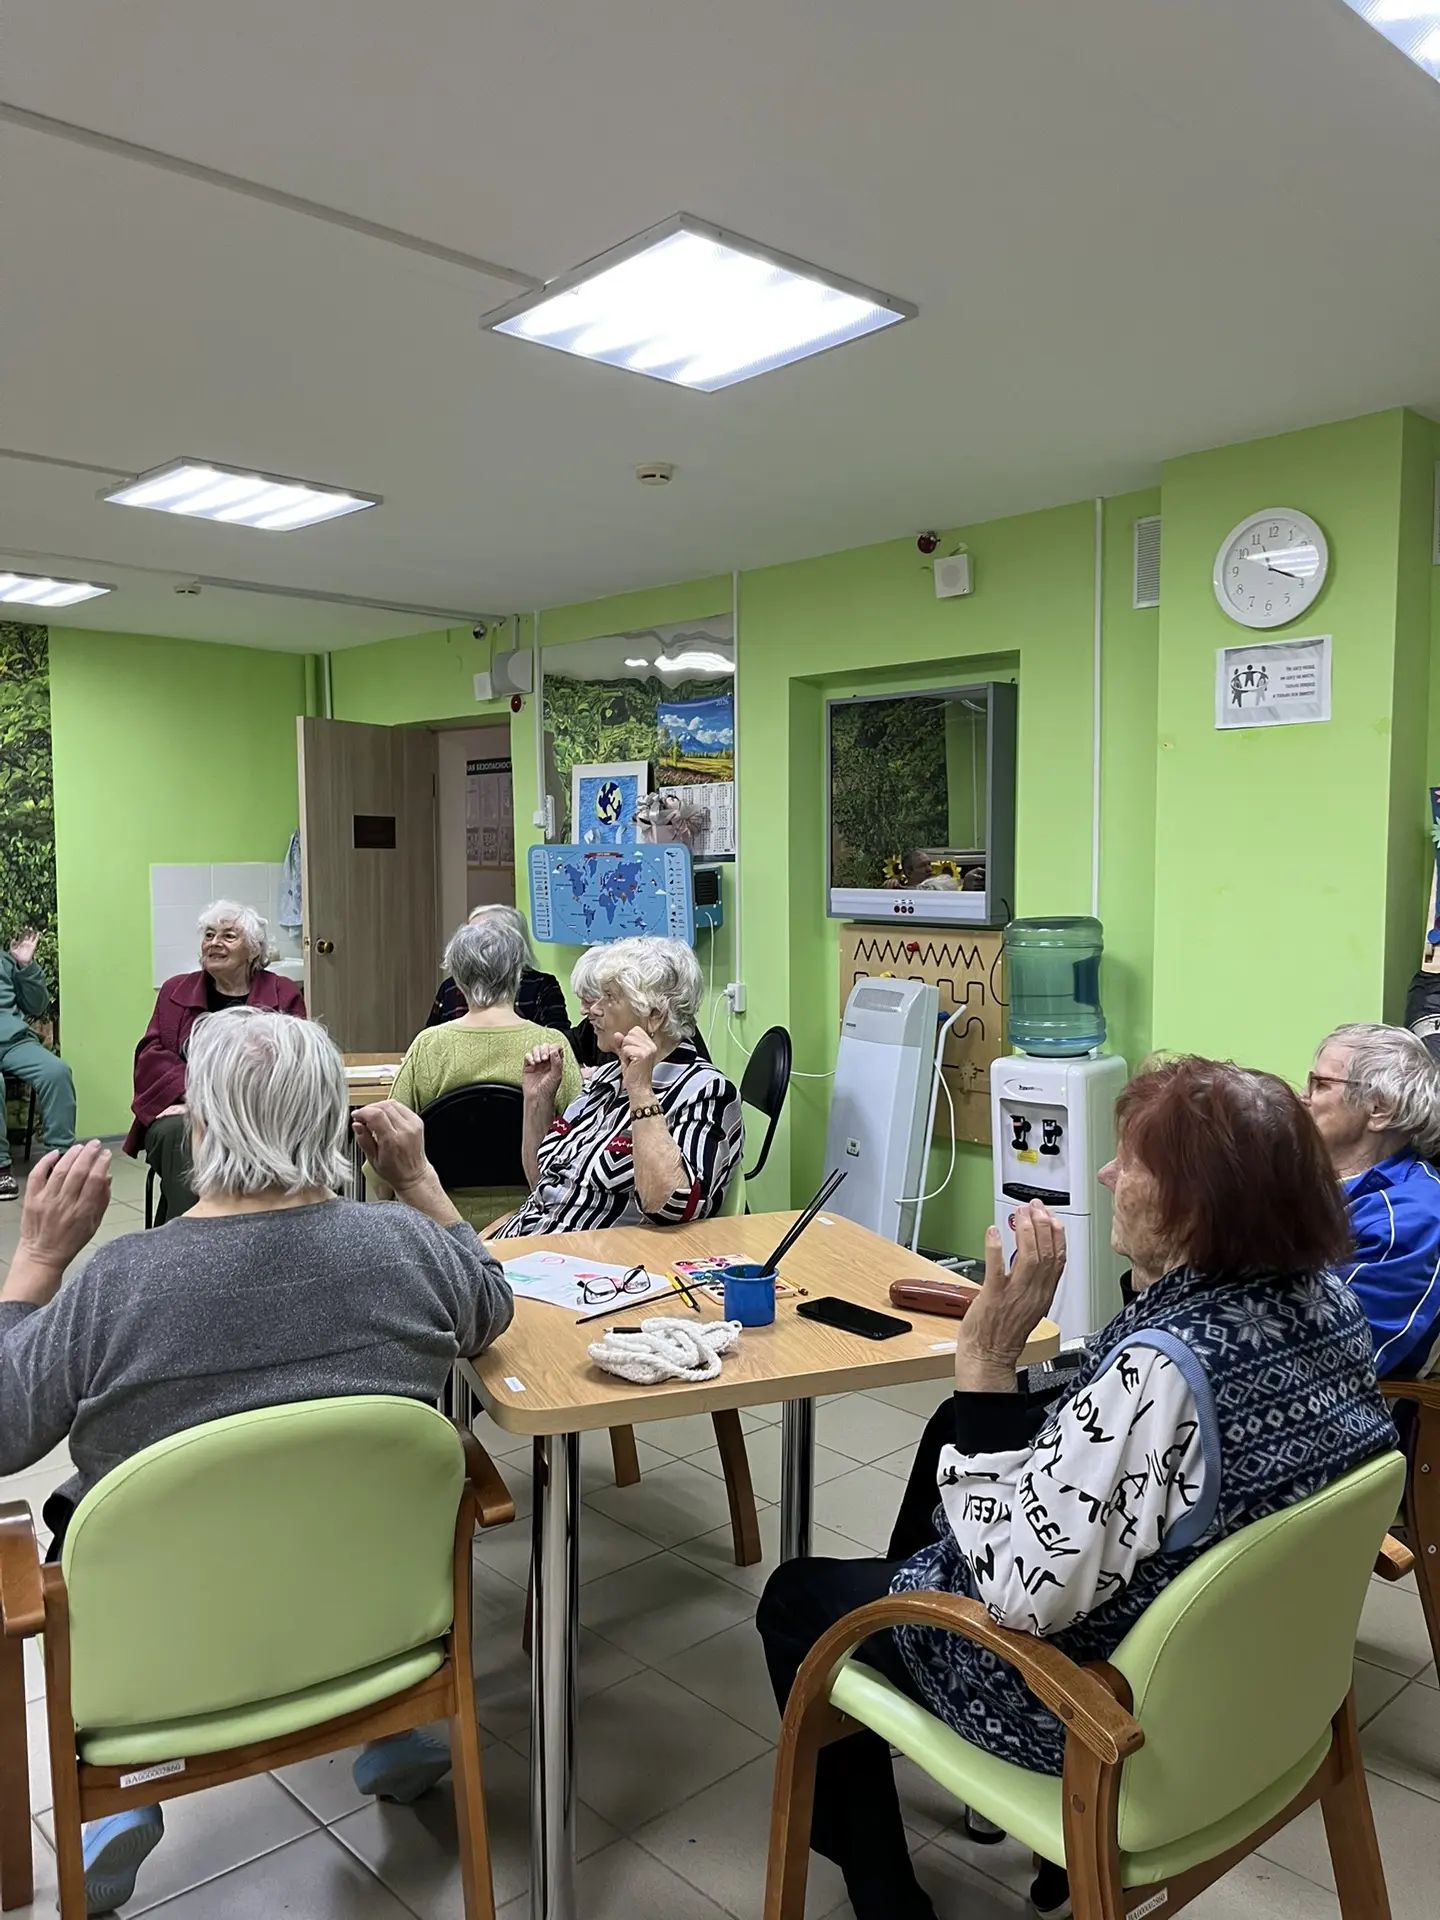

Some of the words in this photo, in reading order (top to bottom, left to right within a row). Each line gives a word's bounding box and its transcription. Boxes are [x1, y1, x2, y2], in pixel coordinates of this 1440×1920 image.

[1268, 525, 1279, 538] 12
[1288, 529, 1293, 541] 1
[1251, 533, 1261, 546] 11
[1238, 547, 1249, 560] 10
[1232, 566, 1239, 578] 9
[1236, 583, 1244, 595] 8
[1249, 595, 1255, 607] 7
[1284, 592, 1290, 604] 5
[1264, 600, 1272, 611] 6
